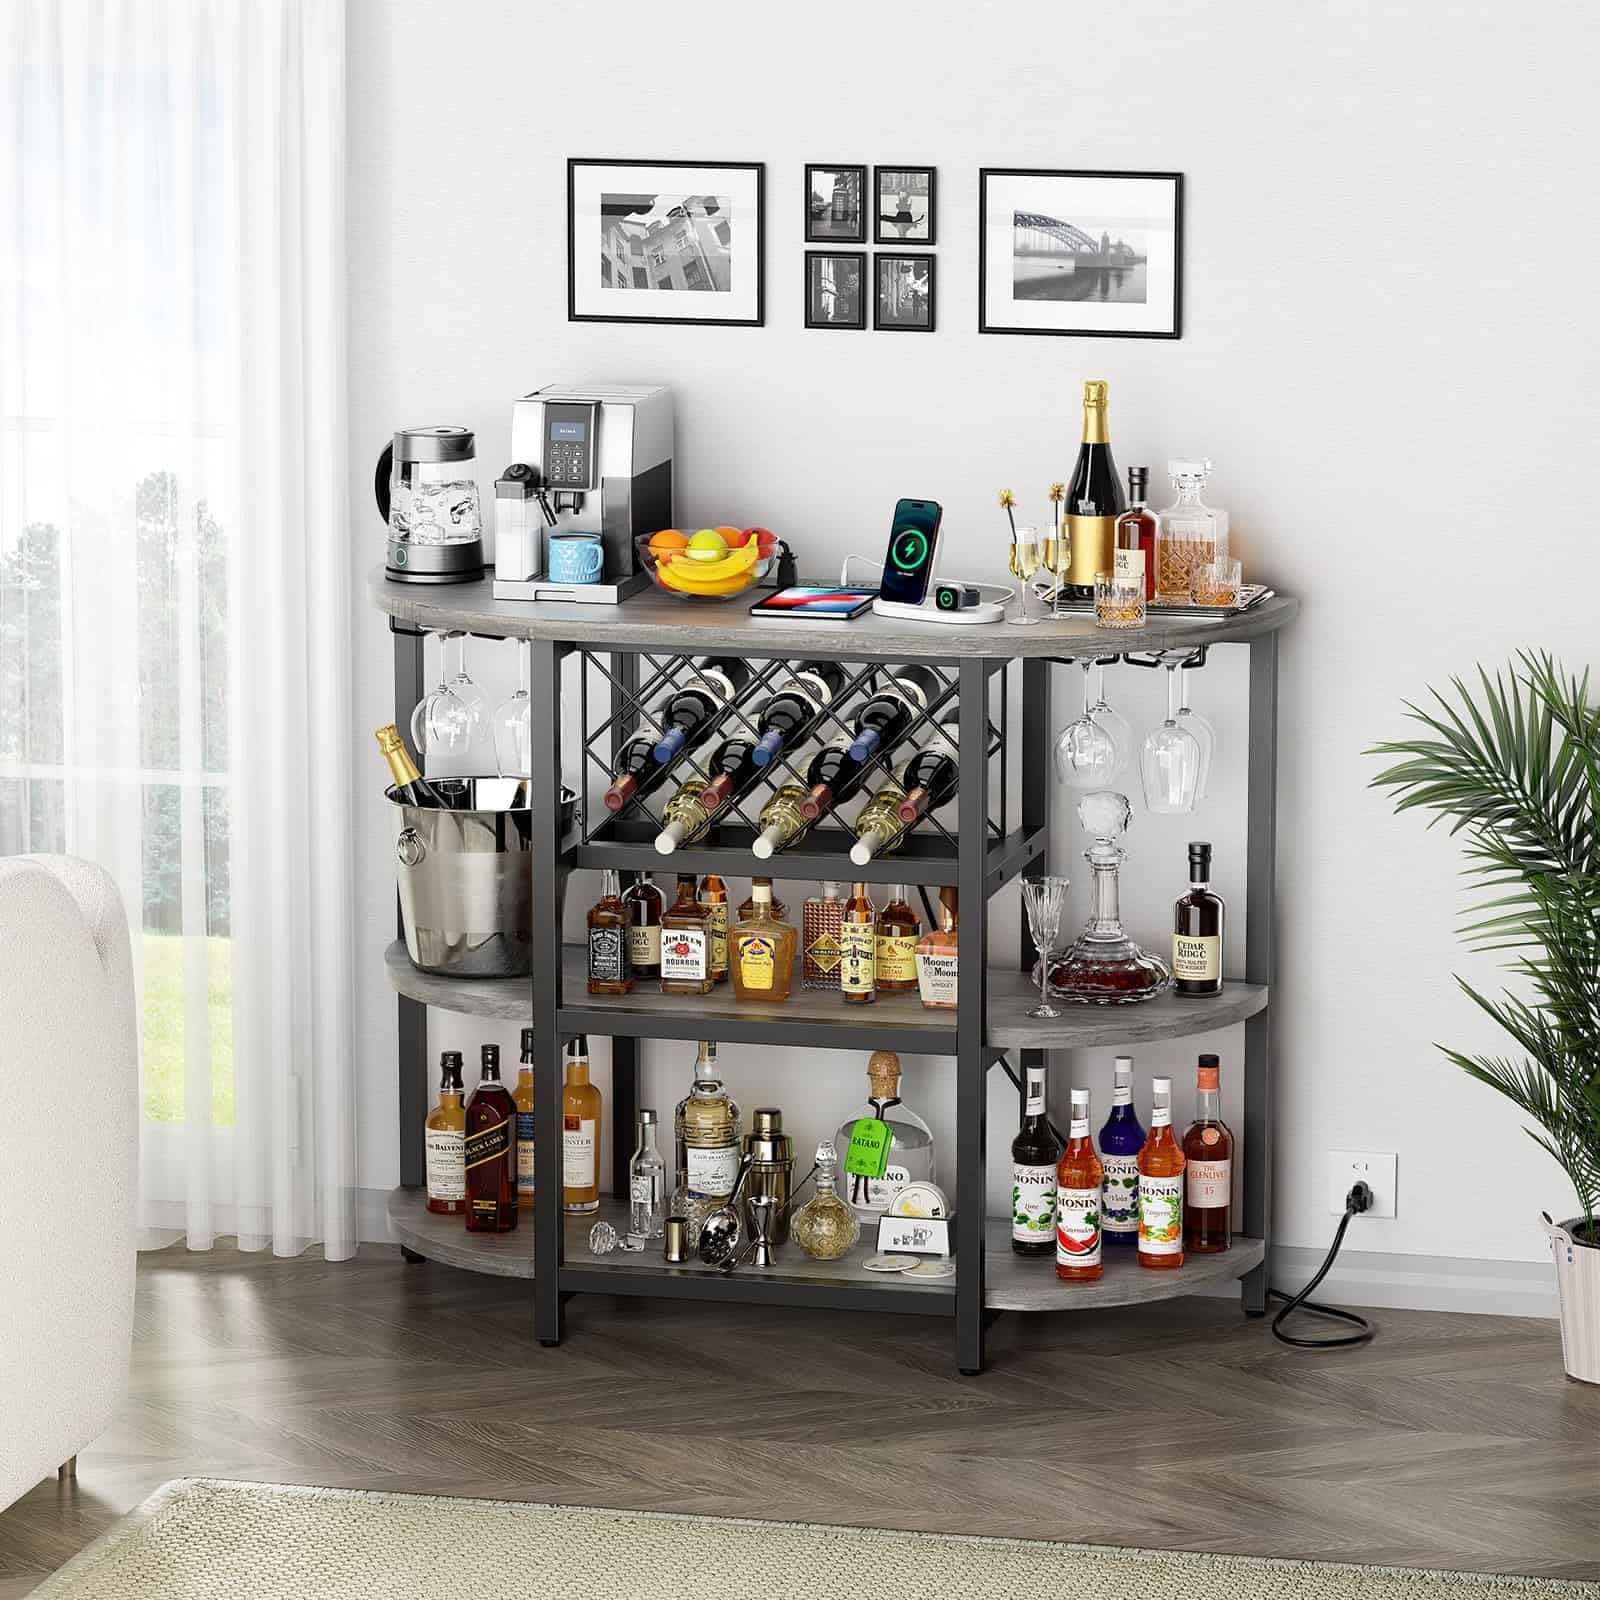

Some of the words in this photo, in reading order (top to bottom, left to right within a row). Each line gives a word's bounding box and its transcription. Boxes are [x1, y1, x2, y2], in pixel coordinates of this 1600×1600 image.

[663, 934, 678, 946] JIM
[1177, 940, 1205, 950] CEDAR
[665, 958, 700, 967] BOURBON
[1013, 1173, 1055, 1185] MONIN
[1139, 1185, 1179, 1196] MONIN
[1057, 1196, 1098, 1208] MONIN
